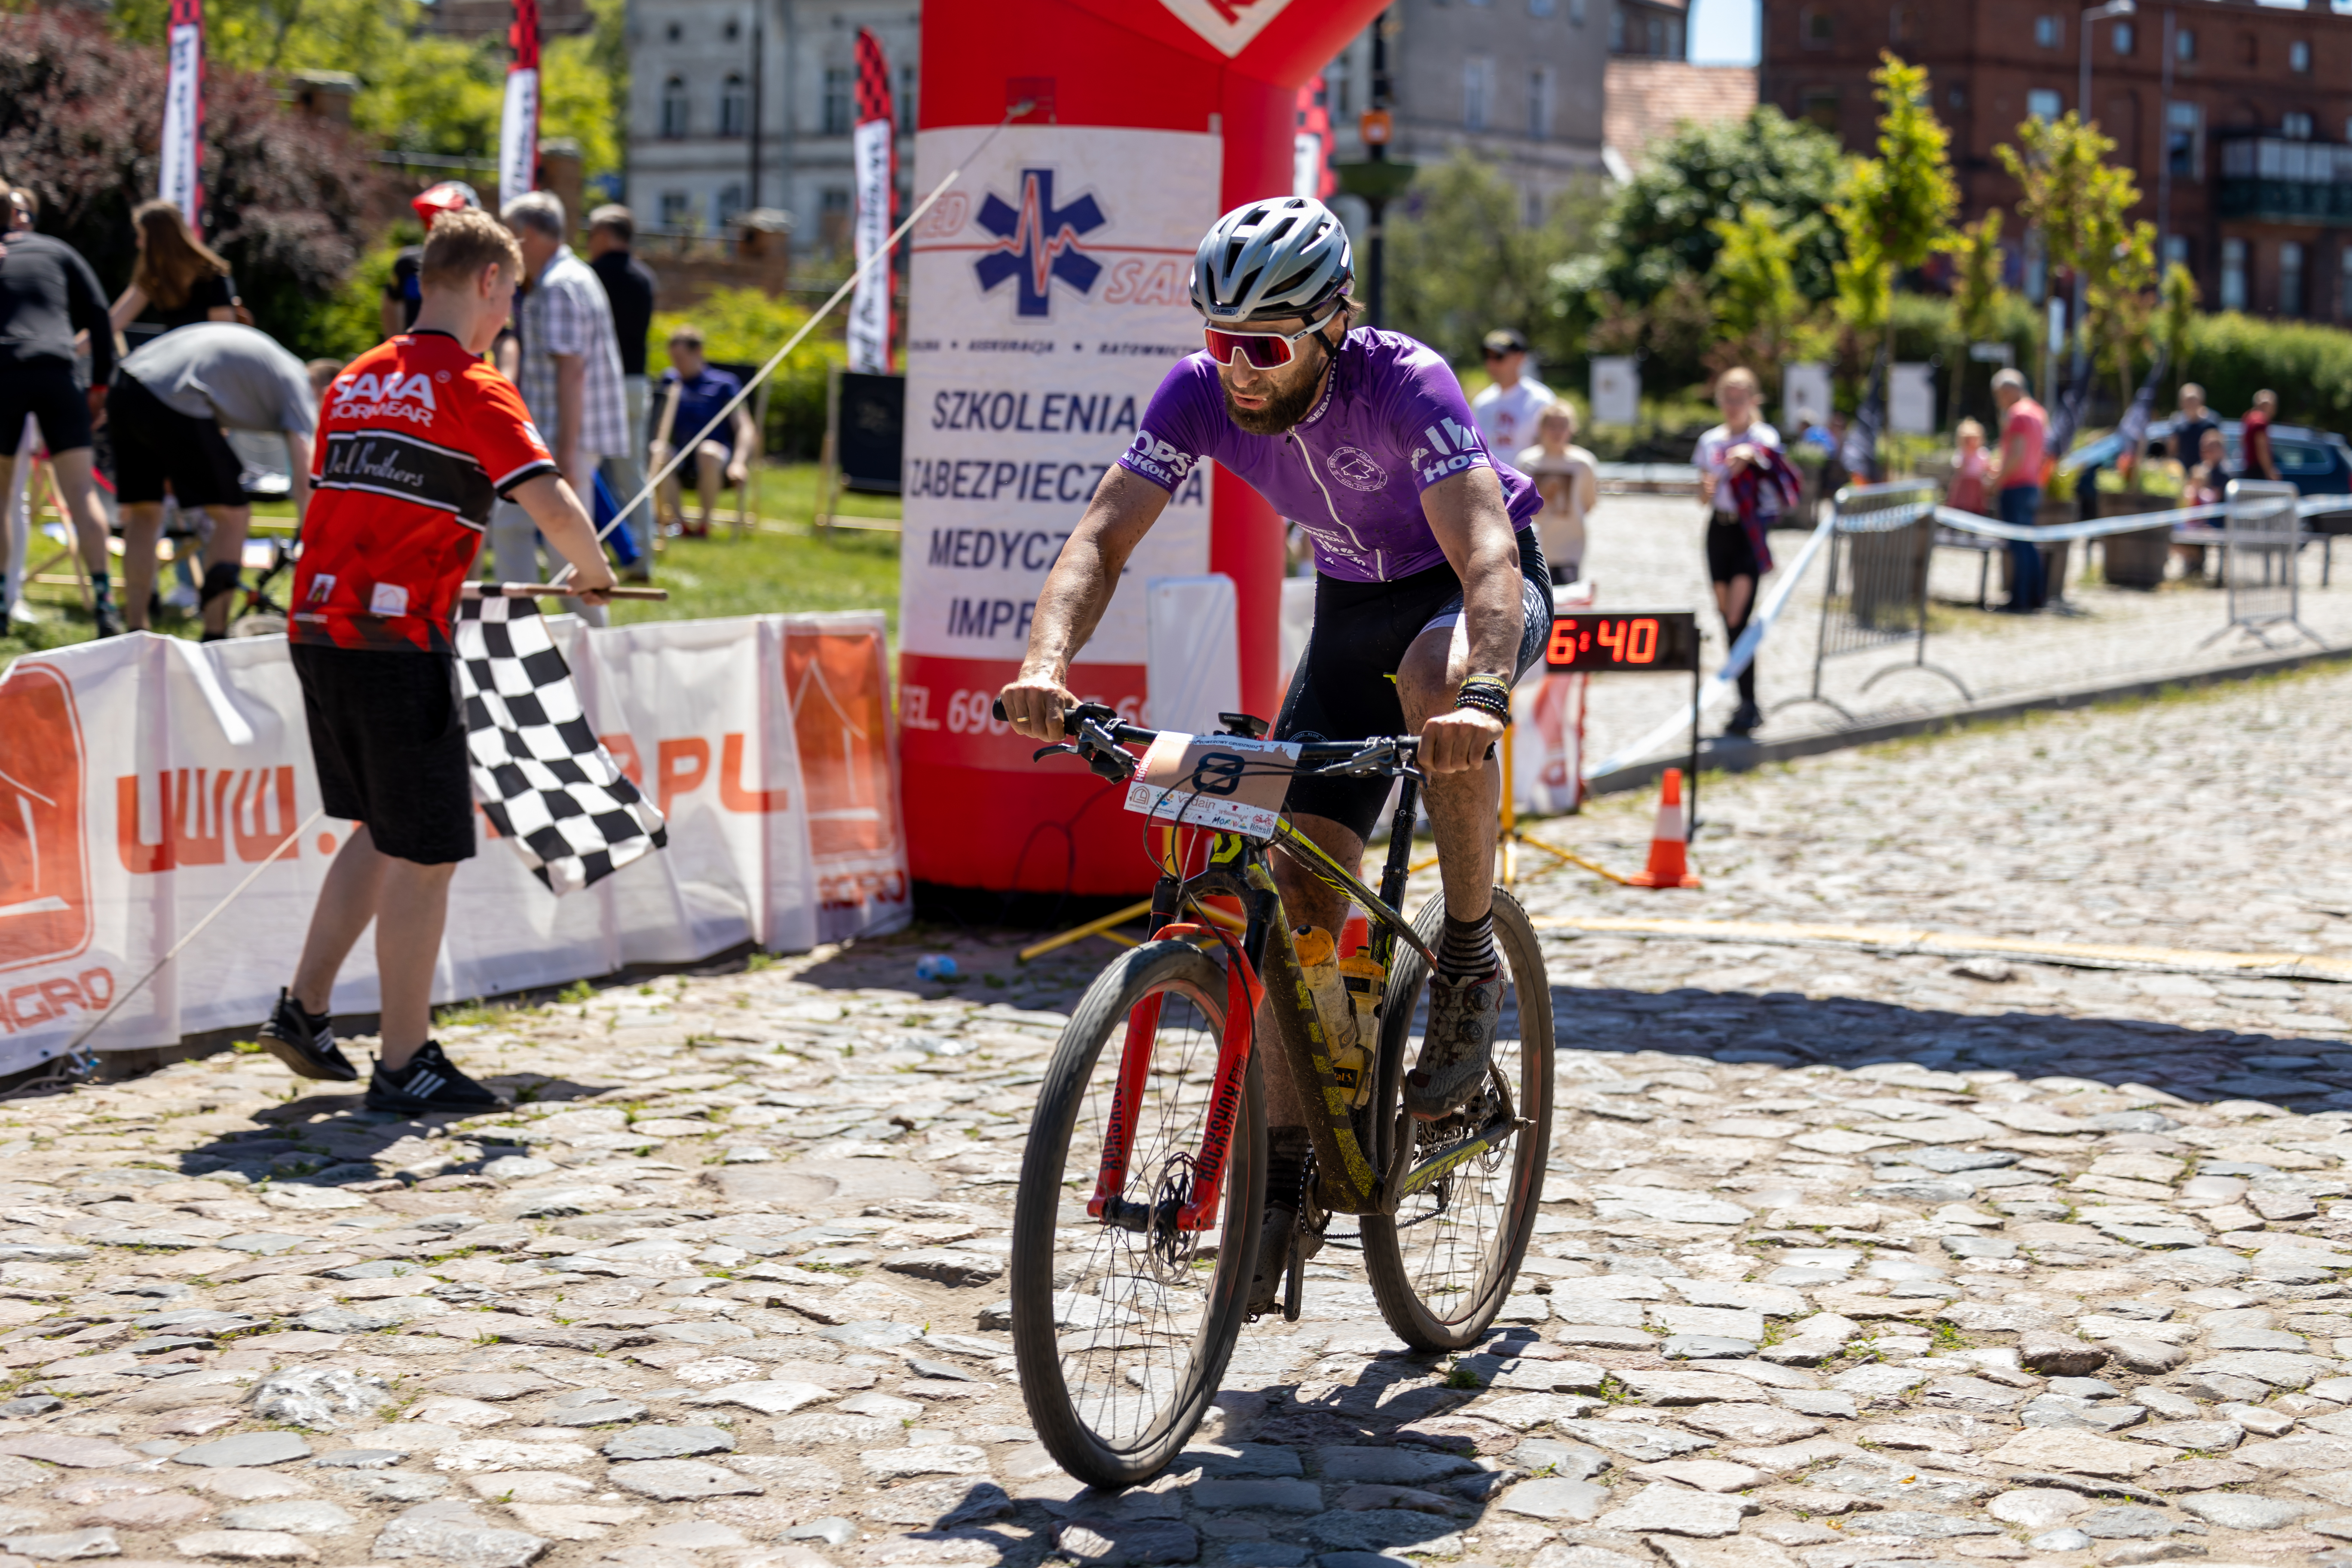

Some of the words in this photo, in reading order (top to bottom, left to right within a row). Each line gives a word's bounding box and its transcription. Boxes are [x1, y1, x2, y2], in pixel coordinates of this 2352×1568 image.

[333, 371, 437, 411] SARA
[932, 392, 1138, 434] SZKOLENIA
[909, 460, 1204, 506] ZABEZPIECZA
[1148, 473, 1169, 488] Company
[928, 529, 1130, 573] MEDYCZ
[1192, 752, 1245, 796] 8
[1196, 1084, 1242, 1182] ROCKSHOX
